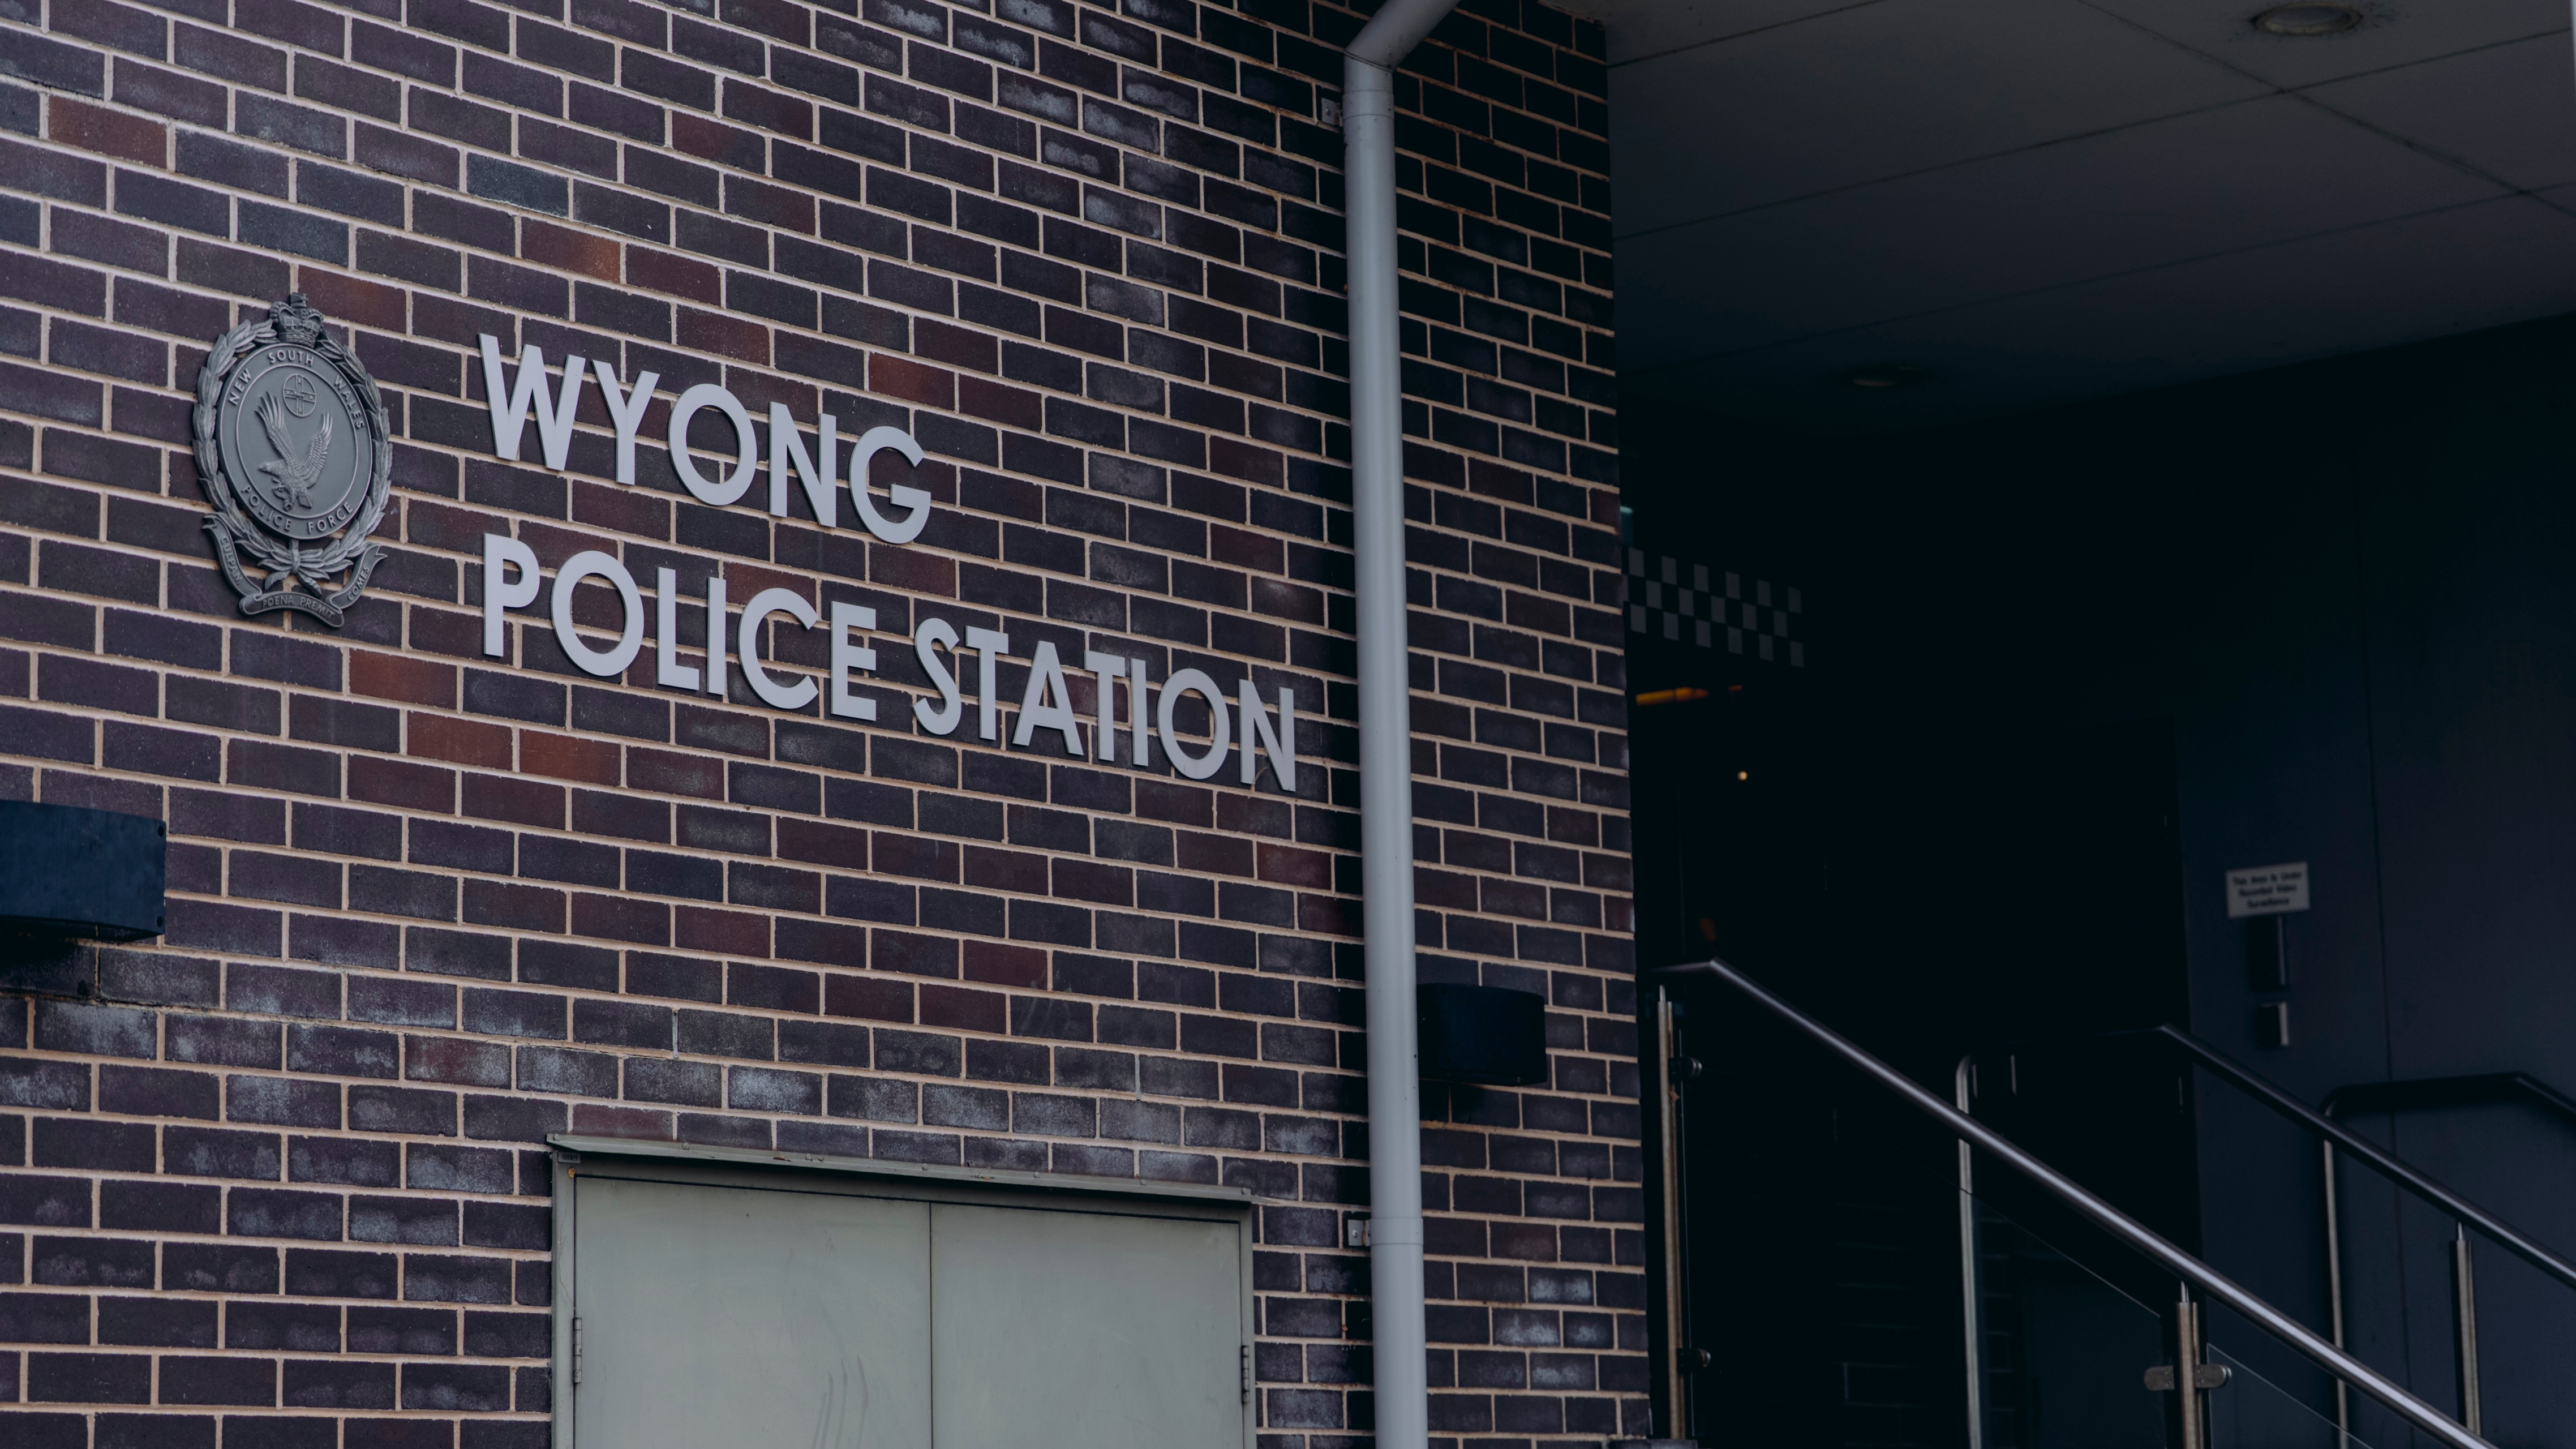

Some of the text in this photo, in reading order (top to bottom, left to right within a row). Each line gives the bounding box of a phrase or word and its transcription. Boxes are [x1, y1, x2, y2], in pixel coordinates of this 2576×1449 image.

[227, 349, 364, 430] NEW SOUTH WALES
[478, 333, 931, 545] WYONG
[241, 485, 353, 534] POLICE FORCE
[221, 537, 370, 620] CULPAM POENA PREMIT COMES
[482, 533, 1295, 792] POLICE STATION
